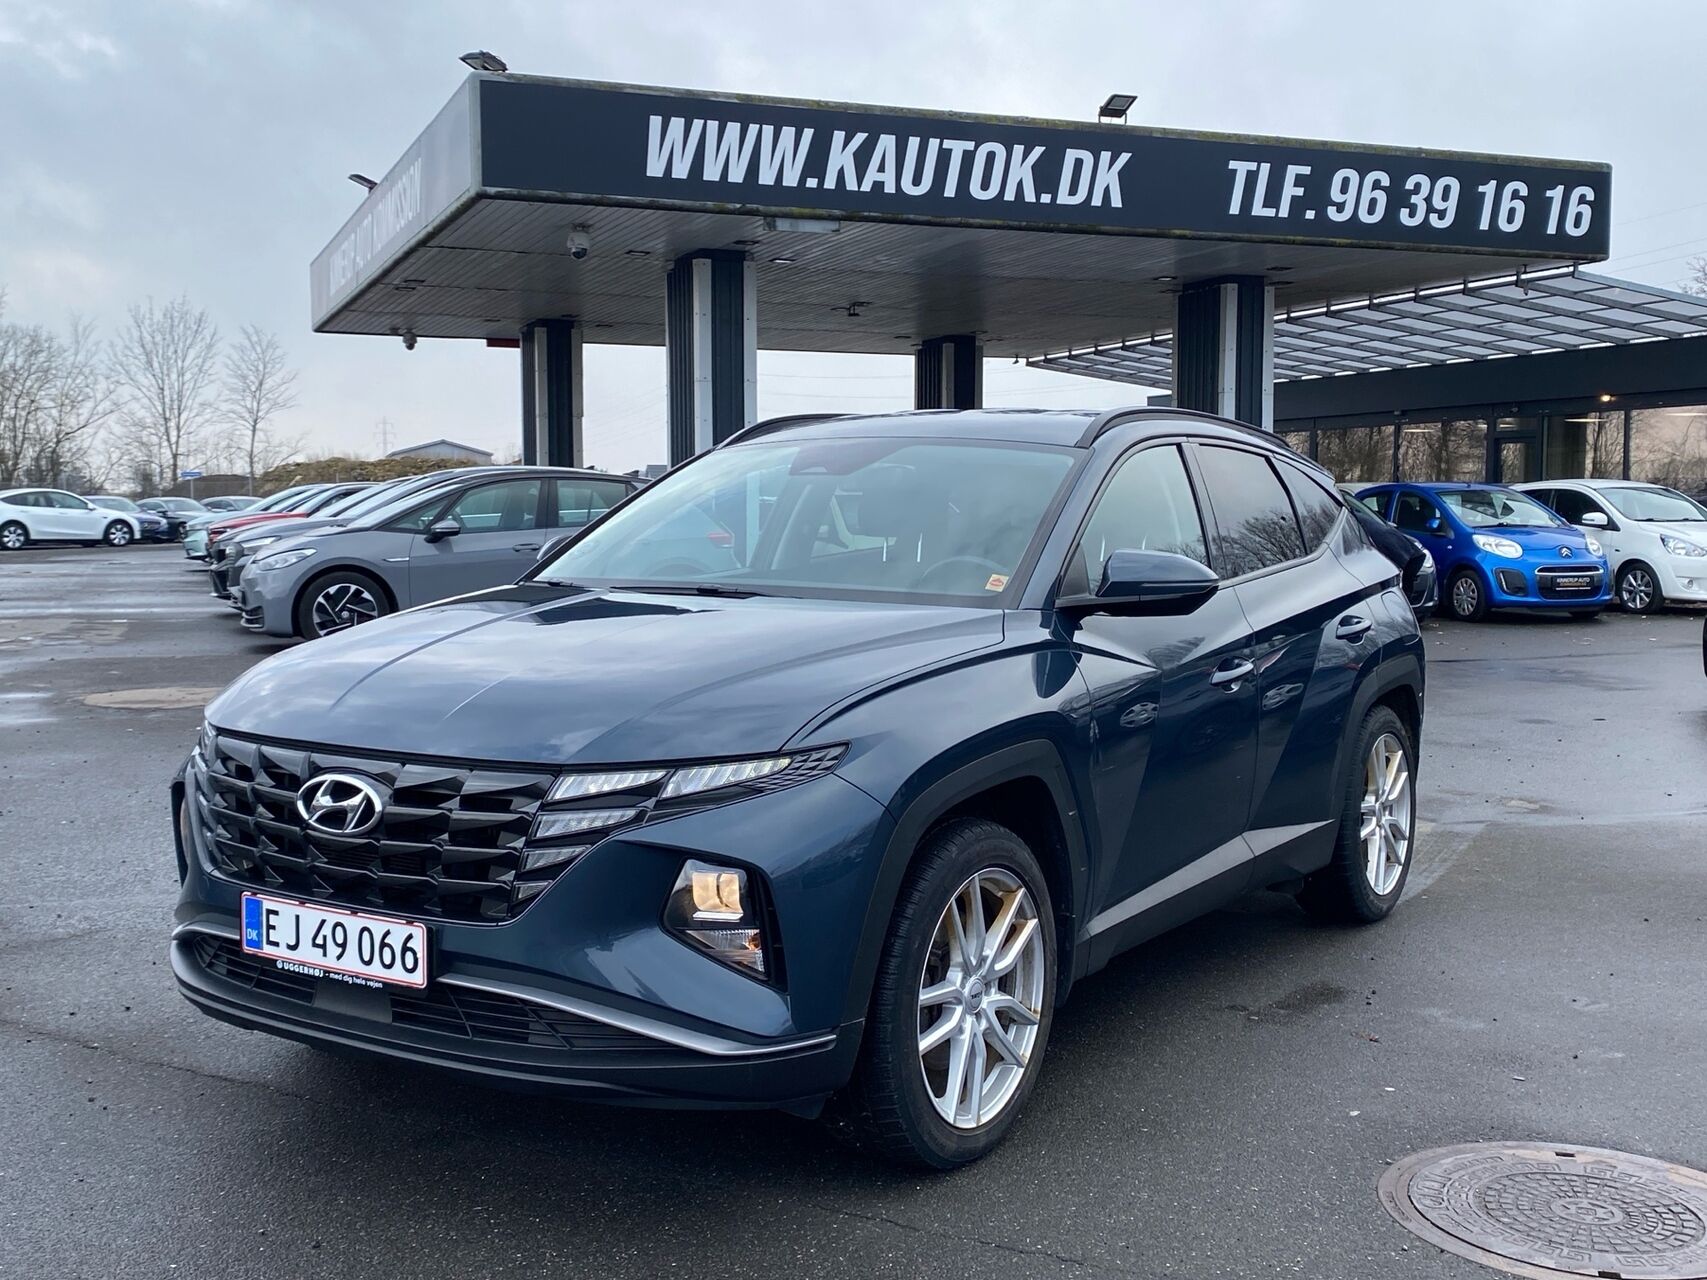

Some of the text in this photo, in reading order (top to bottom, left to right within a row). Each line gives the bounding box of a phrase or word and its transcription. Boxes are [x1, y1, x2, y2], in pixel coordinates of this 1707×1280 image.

[646, 115, 1132, 208] WWW.KAUTOK.DK
[1227, 160, 1595, 238] TLF. 96 39 16 16
[246, 928, 258, 941] DK
[265, 908, 419, 974] EJ 49 066
[283, 962, 324, 977] UGGERHØJ
